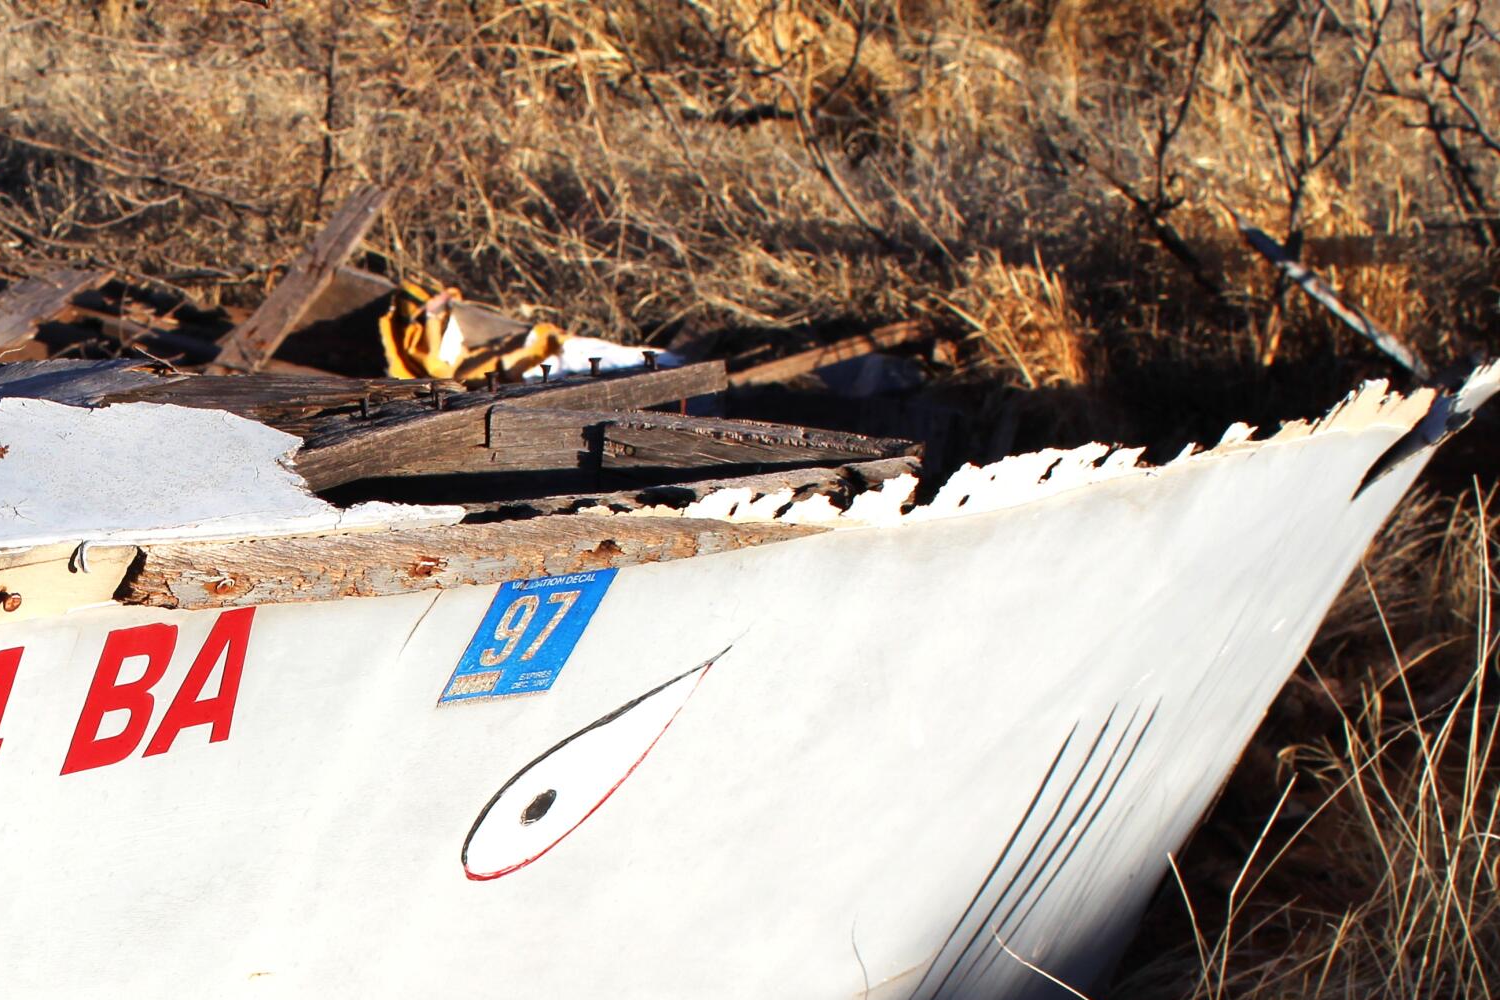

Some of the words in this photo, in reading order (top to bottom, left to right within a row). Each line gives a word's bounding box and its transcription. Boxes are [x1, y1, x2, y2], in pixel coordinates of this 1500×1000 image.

[565, 573, 596, 585] DECAL
[479, 590, 581, 667] 97
[61, 607, 255, 774] BA
